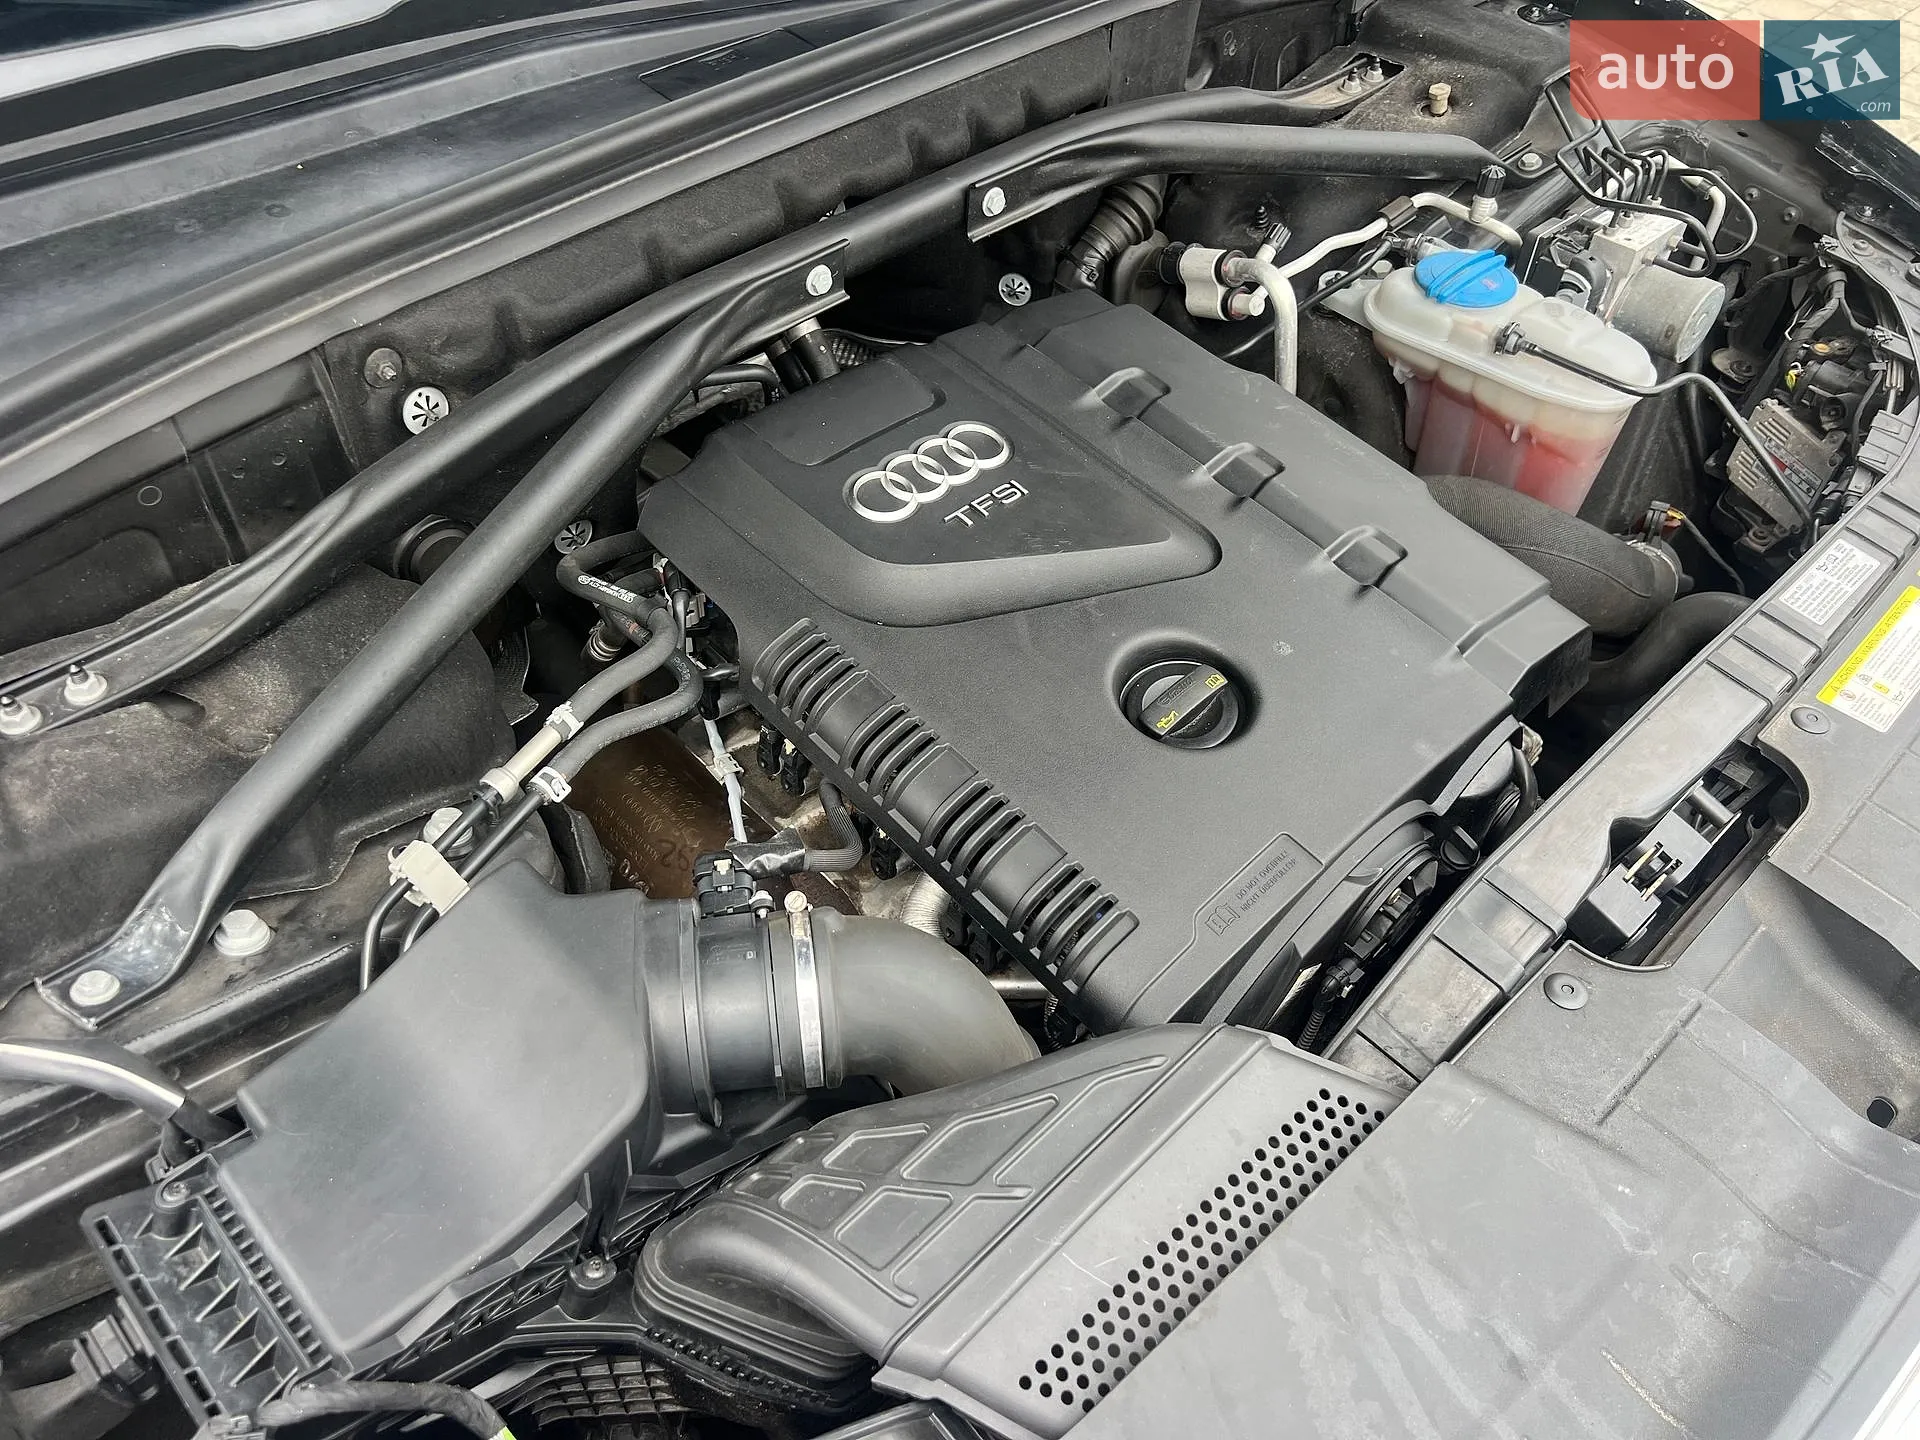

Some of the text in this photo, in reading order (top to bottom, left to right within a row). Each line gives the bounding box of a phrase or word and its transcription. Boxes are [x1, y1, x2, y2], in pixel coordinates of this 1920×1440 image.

[943, 479, 1029, 527] TFSI
[1838, 656, 1863, 687] ACHTUNG
[1861, 627, 1887, 656] WARNING
